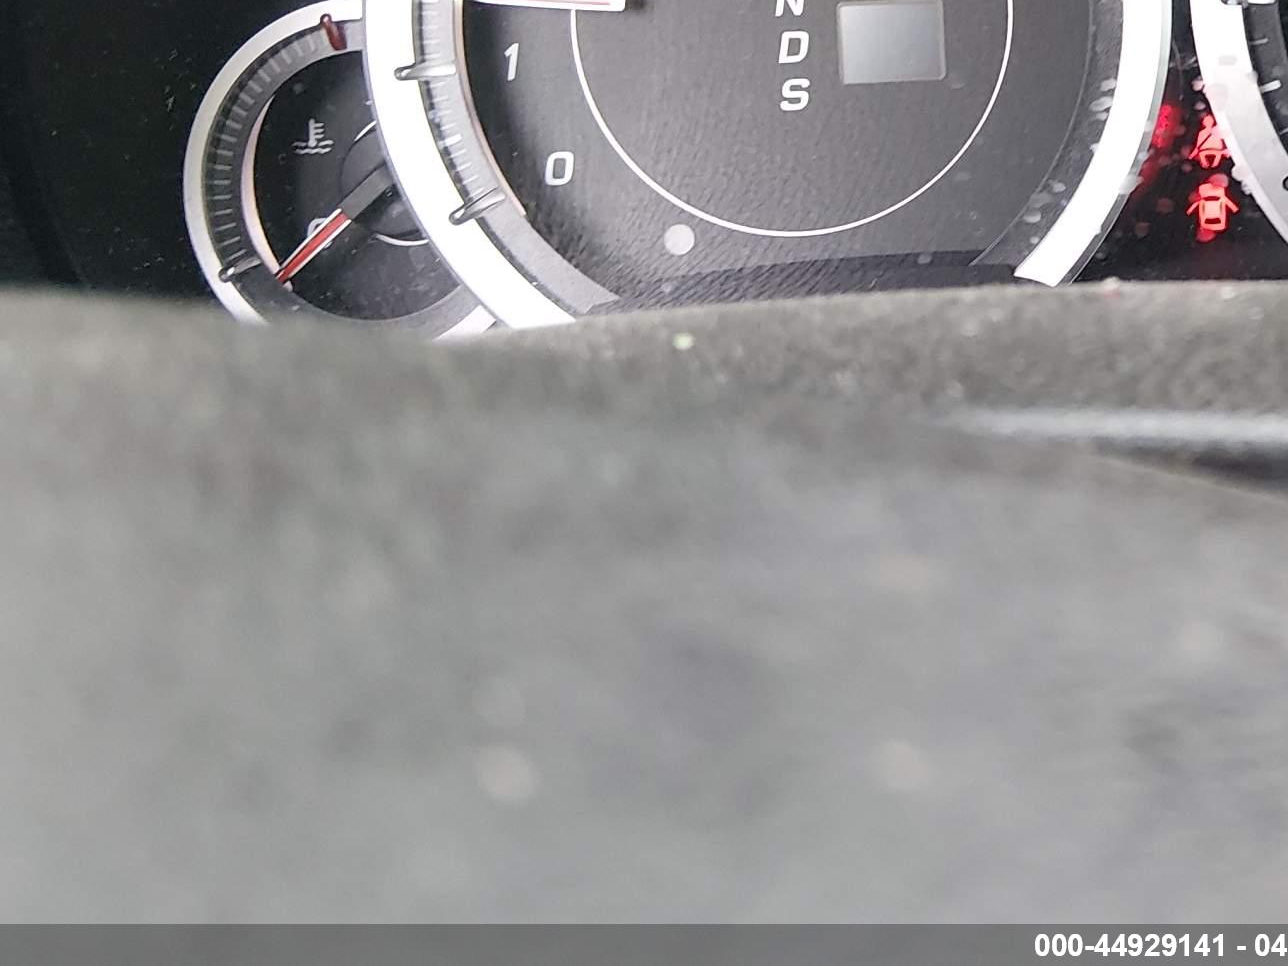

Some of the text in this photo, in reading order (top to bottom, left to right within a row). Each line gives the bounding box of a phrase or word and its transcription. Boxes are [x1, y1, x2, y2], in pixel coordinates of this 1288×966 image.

[504, 42, 520, 81] 1
[778, 30, 810, 64] D
[779, 78, 811, 111] S
[545, 151, 575, 186] 0
